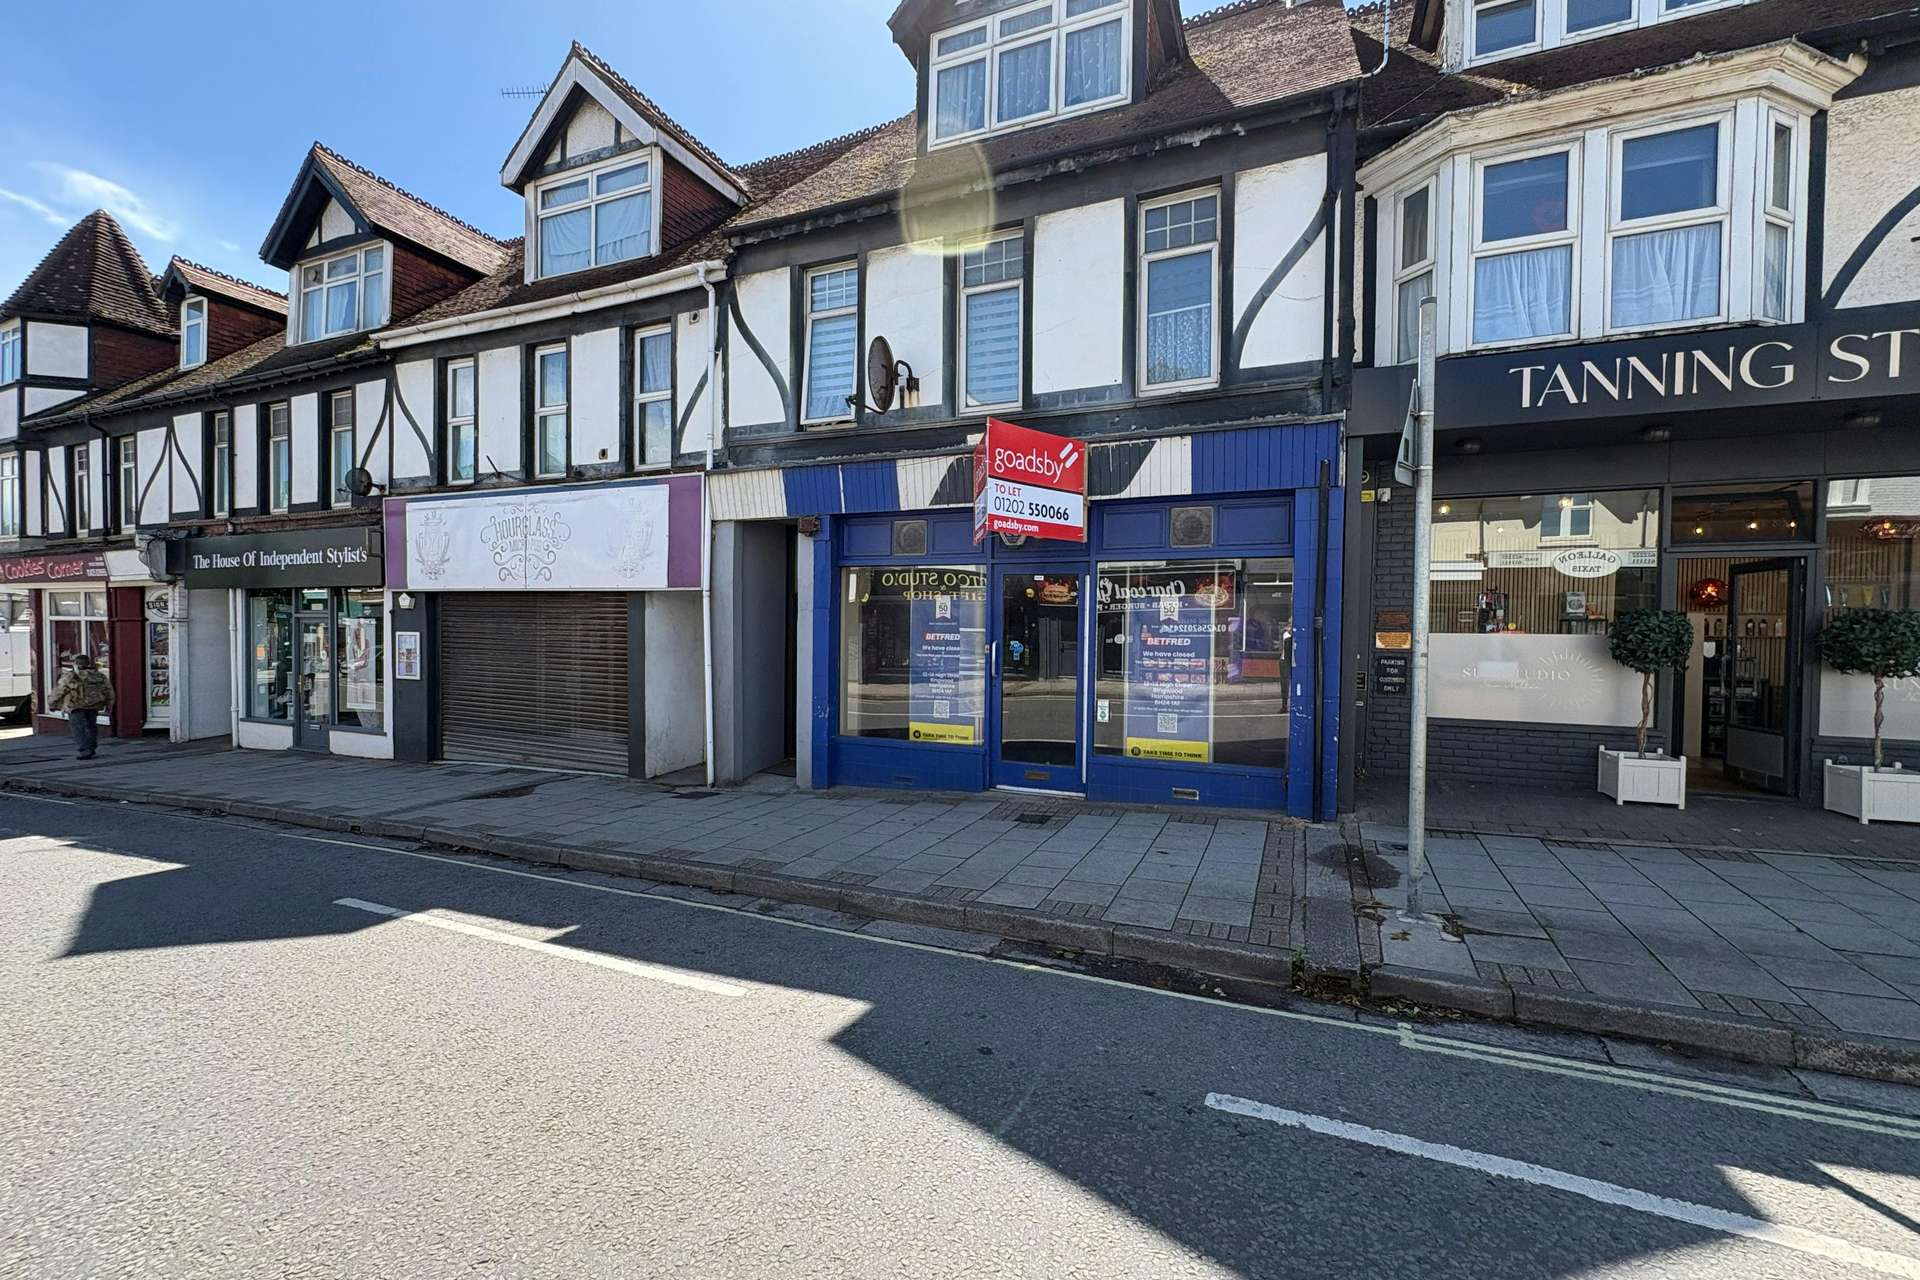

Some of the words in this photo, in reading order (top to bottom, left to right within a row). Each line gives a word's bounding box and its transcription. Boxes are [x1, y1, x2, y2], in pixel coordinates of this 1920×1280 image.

[1508, 341, 1794, 408] TANNING
[1827, 328, 1920, 383] ST
[994, 448, 1064, 483] goadsby
[995, 483, 1005, 494] TO
[1008, 486, 1022, 497] LET
[994, 496, 1025, 515] 01202
[1028, 504, 1069, 521] 550066
[492, 514, 557, 542] HOURGLASS
[993, 519, 1039, 533] goadsby.com
[193, 554, 210, 569] The
[212, 553, 241, 569] House
[243, 551, 257, 567] Of
[260, 549, 324, 570] Independent
[326, 546, 368, 568] Stylist's
[47, 561, 83, 579] Corner
[925, 633, 960, 641] BETFRED
[1147, 637, 1191, 646] BETFRED
